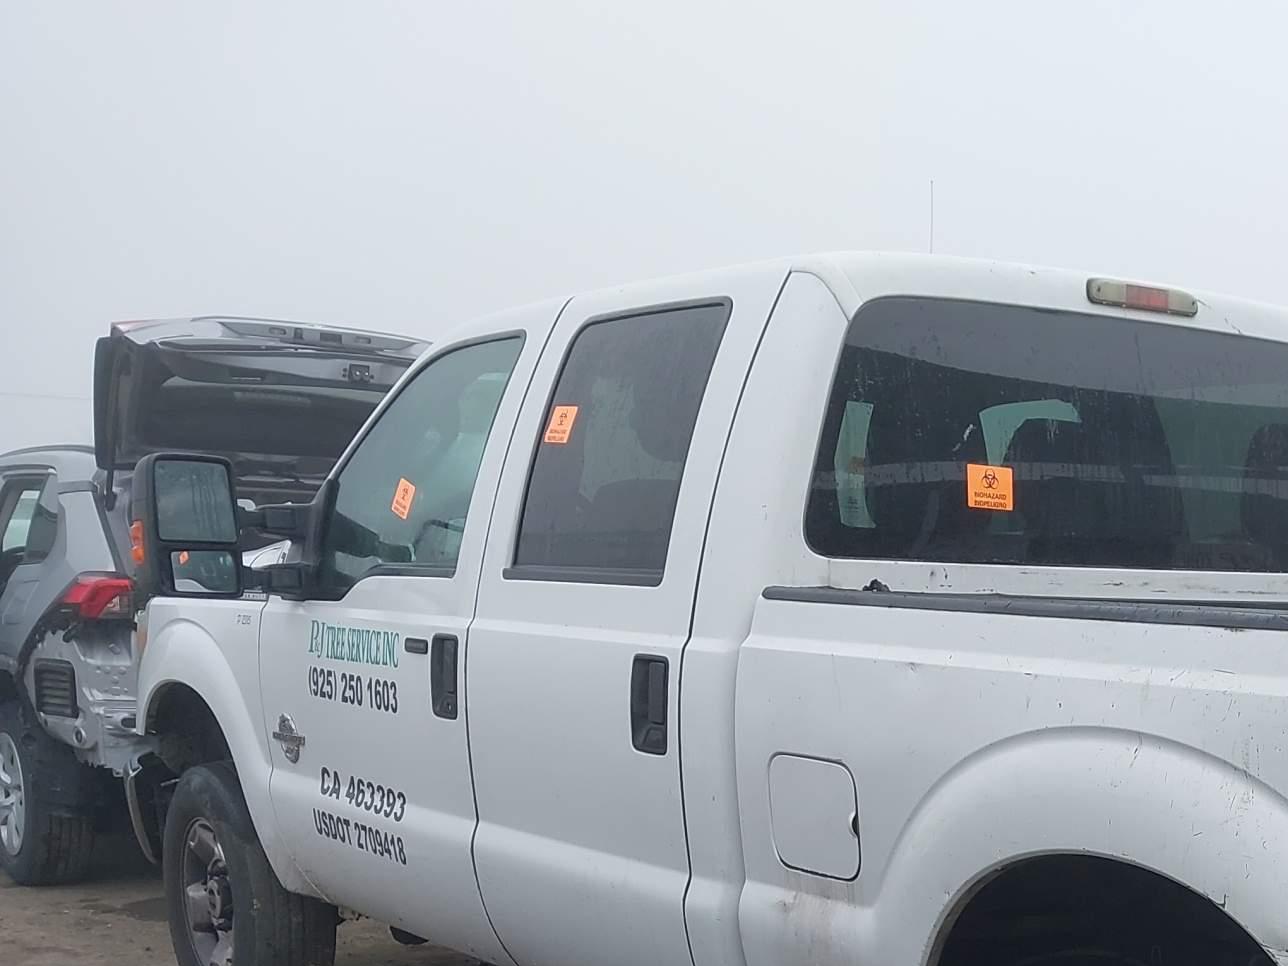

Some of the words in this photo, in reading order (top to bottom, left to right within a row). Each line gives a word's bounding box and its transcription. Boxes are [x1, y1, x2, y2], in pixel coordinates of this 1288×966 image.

[974, 491, 1007, 501] BIOHAZARD
[326, 625, 346, 661] TREE
[346, 627, 382, 666] SERVICE
[382, 631, 400, 669] INC
[308, 665, 337, 702] (925)
[341, 672, 363, 707] 250
[367, 676, 398, 714] 1603
[320, 766, 341, 801] CA
[345, 775, 407, 822] 463393
[313, 807, 352, 847] USDOT
[354, 822, 407, 866] 2709418
